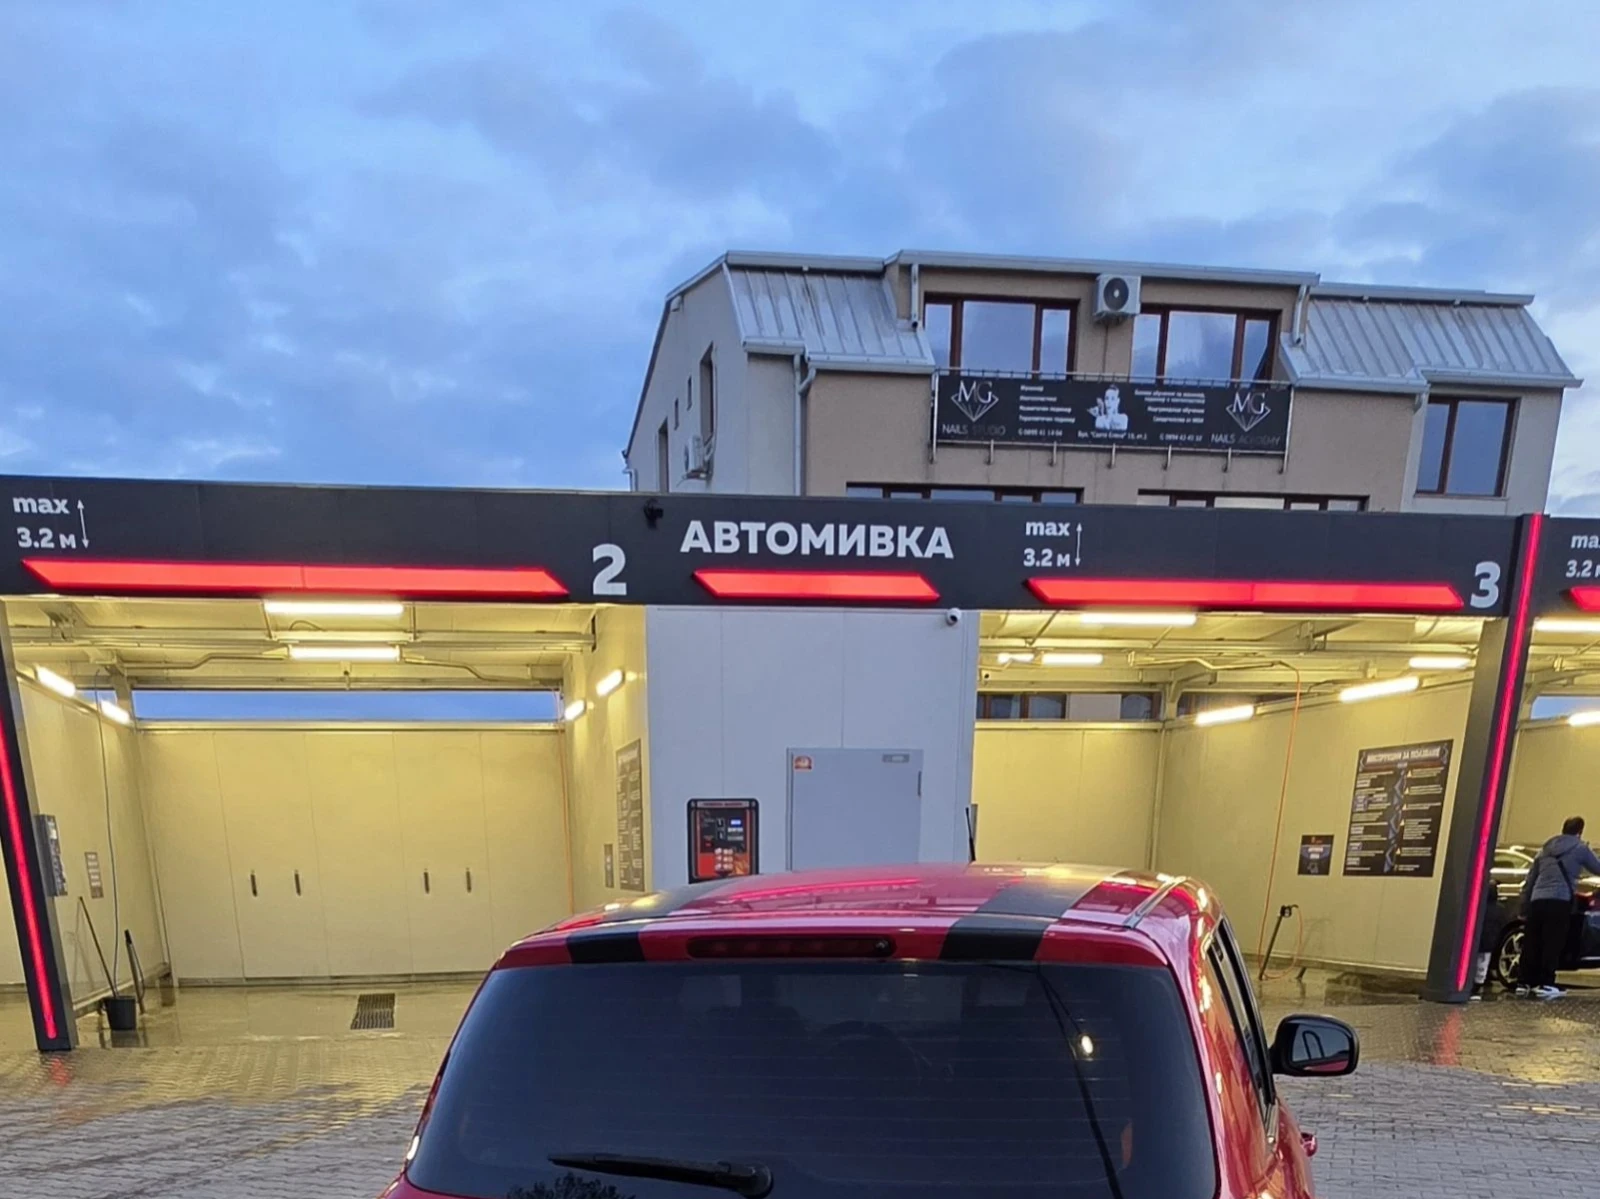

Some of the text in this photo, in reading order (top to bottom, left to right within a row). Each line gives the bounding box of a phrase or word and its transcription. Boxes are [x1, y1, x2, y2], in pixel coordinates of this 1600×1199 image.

[942, 424, 968, 434] NAILS
[1211, 433, 1236, 443] NAILS
[12, 497, 70, 514] max
[17, 526, 55, 548] 3.2
[1025, 522, 1070, 536] max
[680, 520, 954, 558] АВТОМИВКА
[1570, 535, 1600, 549] ma
[1023, 548, 1053, 567] 3.2
[592, 543, 627, 595] 2
[1565, 559, 1593, 577] 3.2
[1470, 561, 1500, 608] 3
